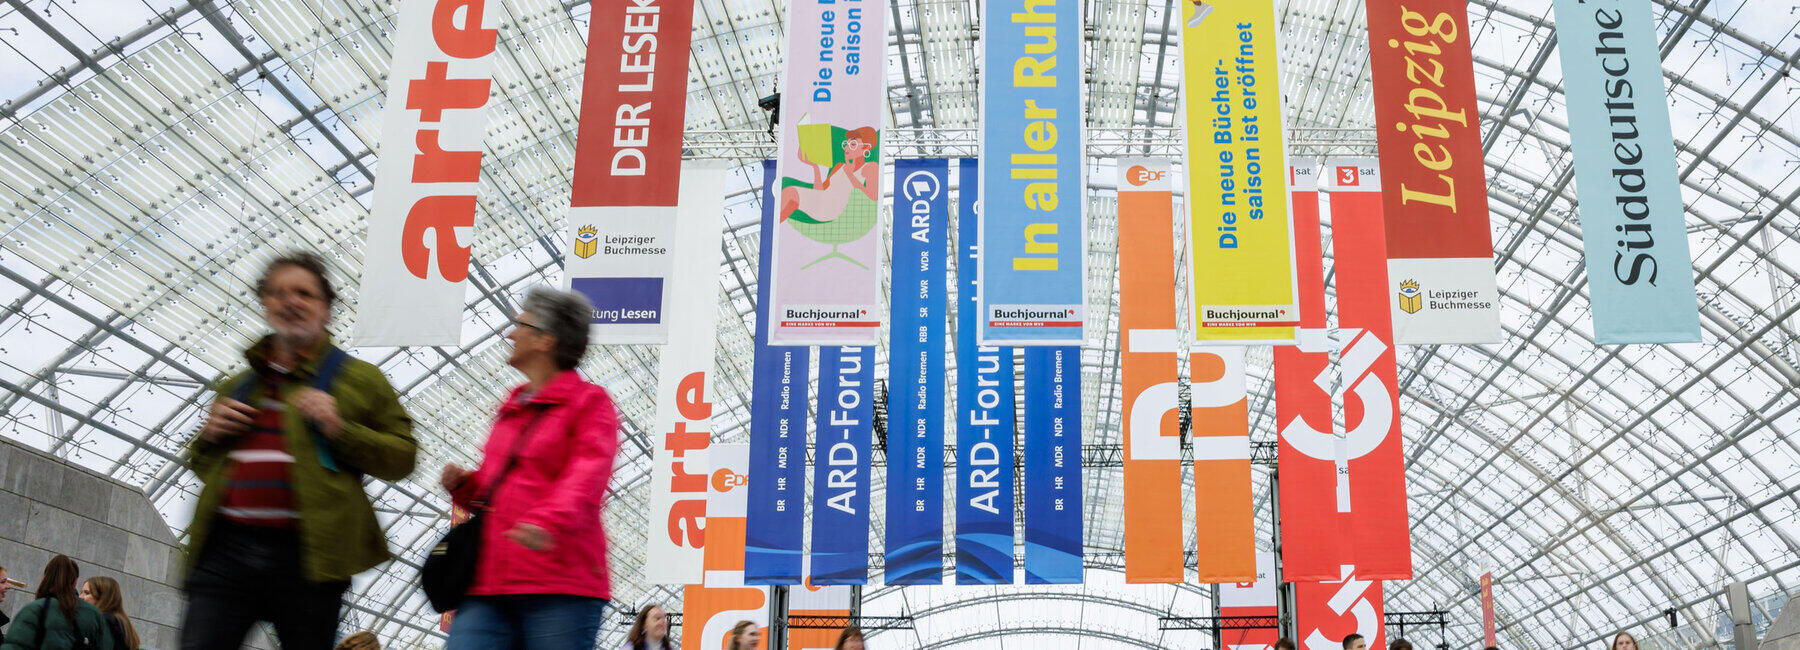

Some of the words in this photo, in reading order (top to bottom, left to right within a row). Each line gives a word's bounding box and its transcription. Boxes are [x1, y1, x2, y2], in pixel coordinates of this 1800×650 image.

[819, 10, 836, 62] neue
[841, 8, 862, 76] saison
[1235, 22, 1256, 110] eröffnet
[813, 67, 833, 102] Die
[1211, 59, 1232, 144] Bücher-
[1388, 5, 1467, 214] Leipzig
[610, 102, 652, 176] DER
[1240, 115, 1259, 142] ist
[402, 0, 498, 283] arte
[1595, 8, 1658, 288] Süddeutsche
[1011, 99, 1058, 212] aller
[1219, 150, 1236, 205] neue
[1243, 148, 1264, 220] saison
[911, 200, 931, 244] ARD
[1217, 211, 1238, 249] Die
[604, 246, 667, 255] Buchmesse
[605, 234, 655, 245] Leipziger
[1013, 223, 1058, 271] In
[921, 251, 929, 272] WDR
[920, 279, 929, 299] SWR
[1428, 289, 1478, 304] Leipziger
[621, 308, 657, 319] Lesen
[786, 309, 860, 321] Buchjournal
[920, 306, 928, 318] SR
[994, 309, 1068, 320] Buchjournal
[1206, 309, 1279, 320] Buchjournal
[1429, 300, 1491, 310] Buchmesse
[919, 325, 928, 343] RBB
[782, 351, 791, 384] Bremen
[919, 351, 927, 384] Bremen
[1054, 350, 1063, 383] Bremen
[781, 386, 790, 410] Radio
[918, 385, 927, 410] Radio
[1054, 384, 1063, 409] Radio
[780, 418, 789, 438] NDR
[917, 418, 926, 438] NDR
[1055, 417, 1063, 437] NDR
[665, 371, 712, 549] arte
[778, 446, 788, 469] MDR
[917, 446, 926, 469] MDR
[1055, 445, 1063, 468] MDR
[778, 477, 787, 491] HR
[917, 477, 925, 491] HR
[1055, 476, 1063, 490] HR
[776, 499, 786, 512] BR
[916, 499, 925, 512] BR
[1055, 498, 1064, 511] BR
